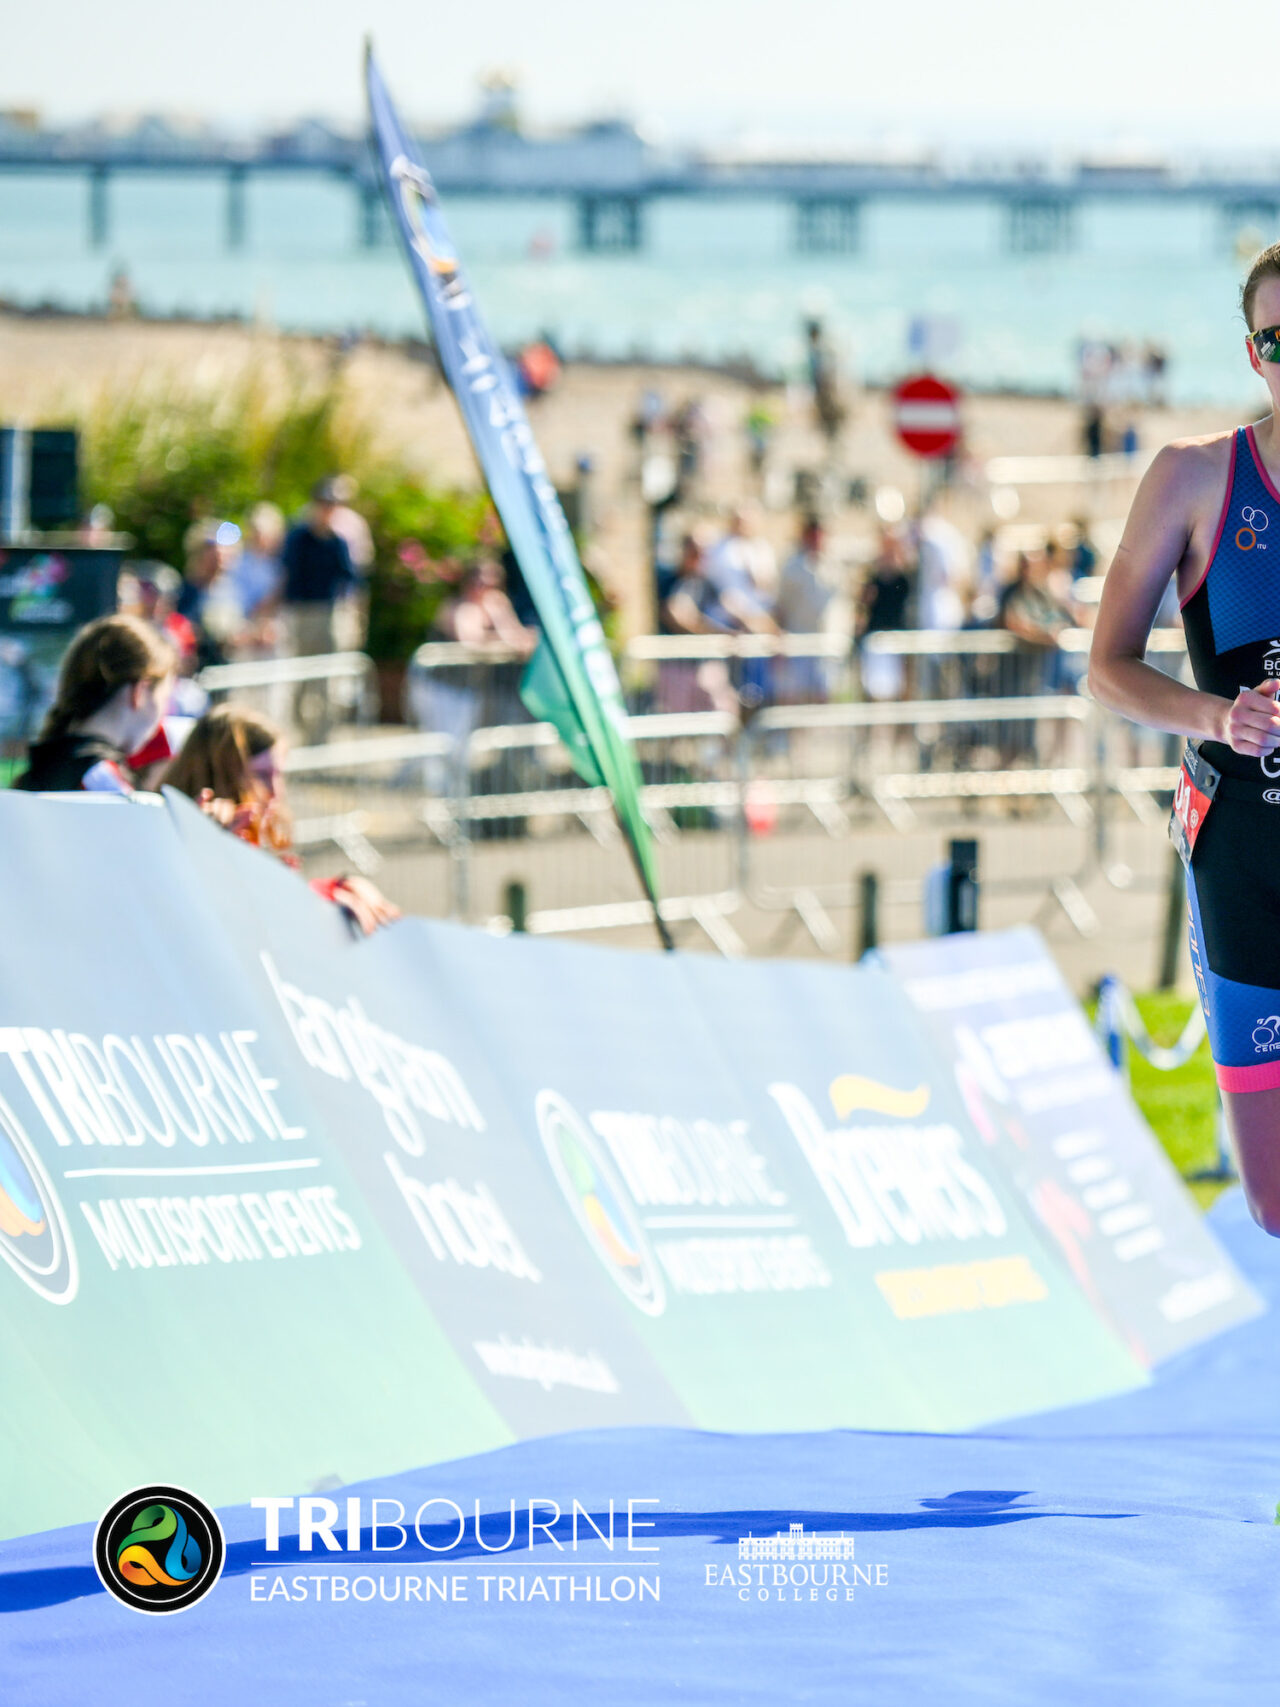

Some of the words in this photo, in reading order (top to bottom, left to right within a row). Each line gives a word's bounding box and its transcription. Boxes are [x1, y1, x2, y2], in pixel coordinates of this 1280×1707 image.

[1256, 543, 1268, 551] ITU
[0, 1027, 306, 1147] TRIBOURNE
[80, 1194, 264, 1272] MULTISPORT
[239, 1185, 362, 1260] EVENTS
